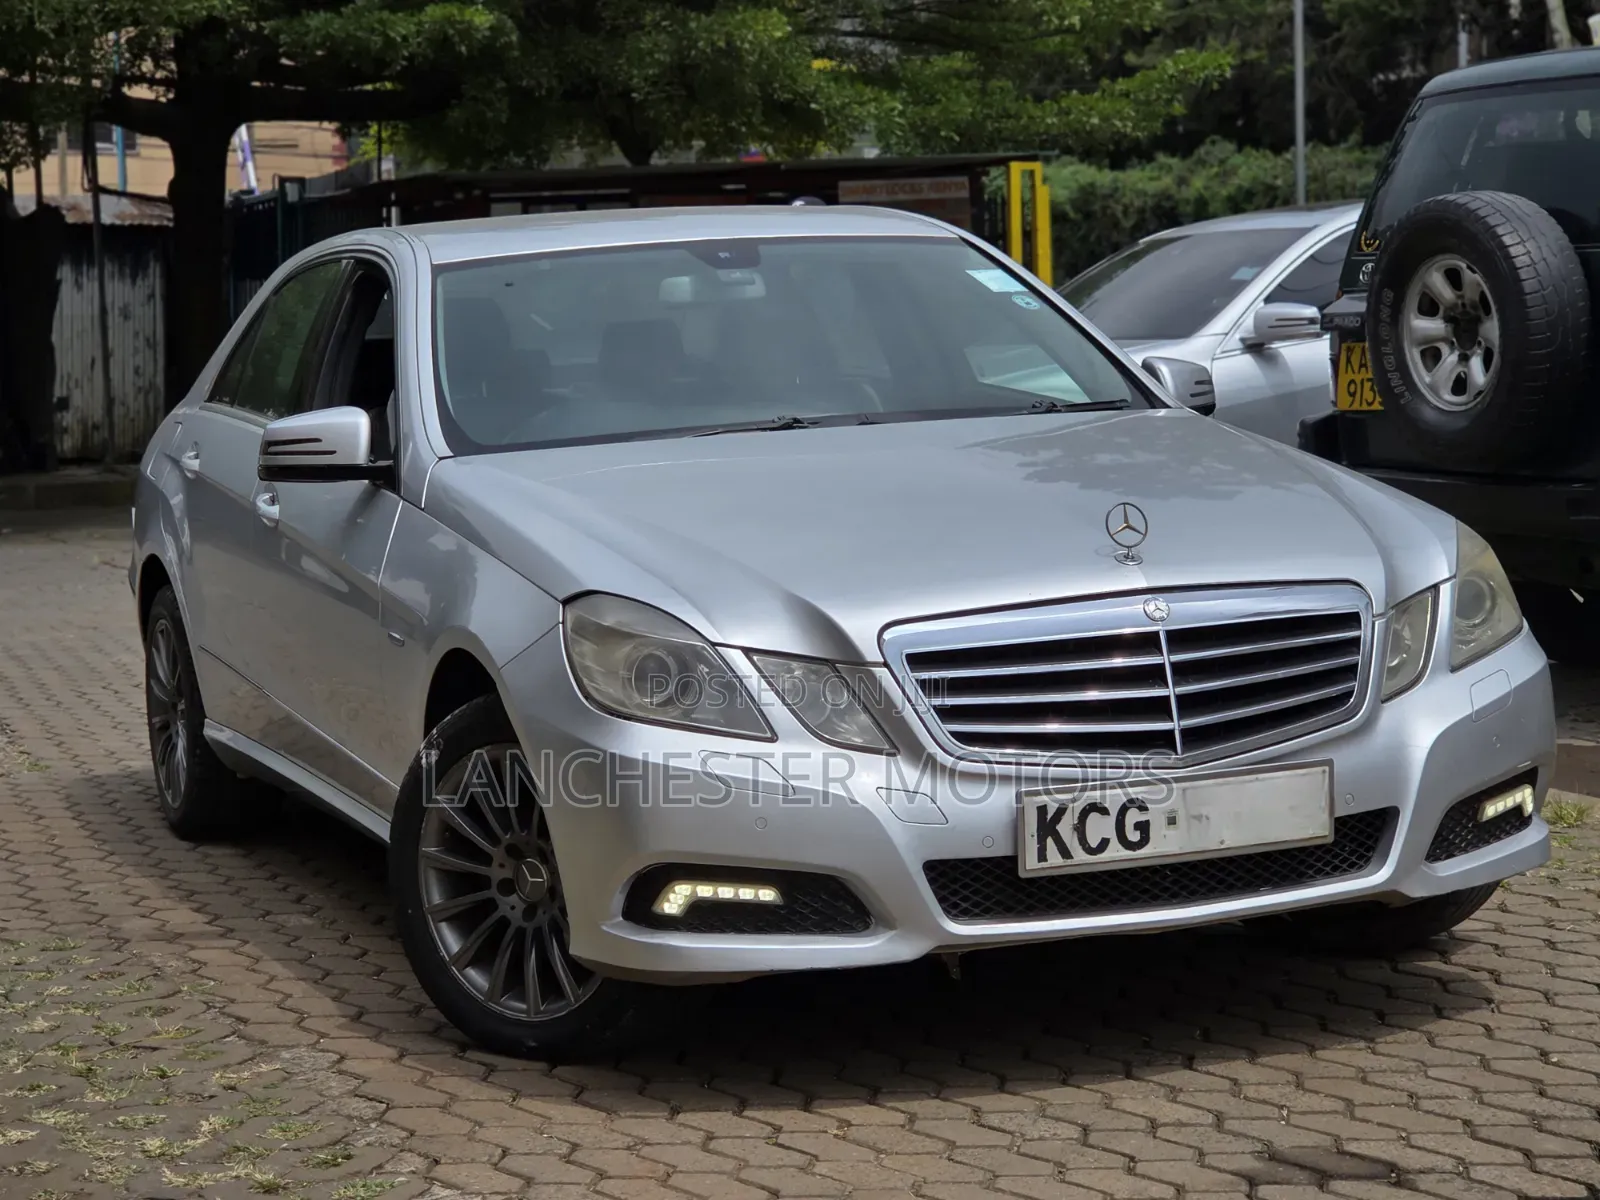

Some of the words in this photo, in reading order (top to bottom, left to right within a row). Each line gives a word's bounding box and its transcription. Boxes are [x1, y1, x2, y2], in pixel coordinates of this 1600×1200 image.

[1379, 288, 1412, 404] LINGLONG
[1346, 377, 1382, 408] 913
[1036, 797, 1151, 864] KCG
